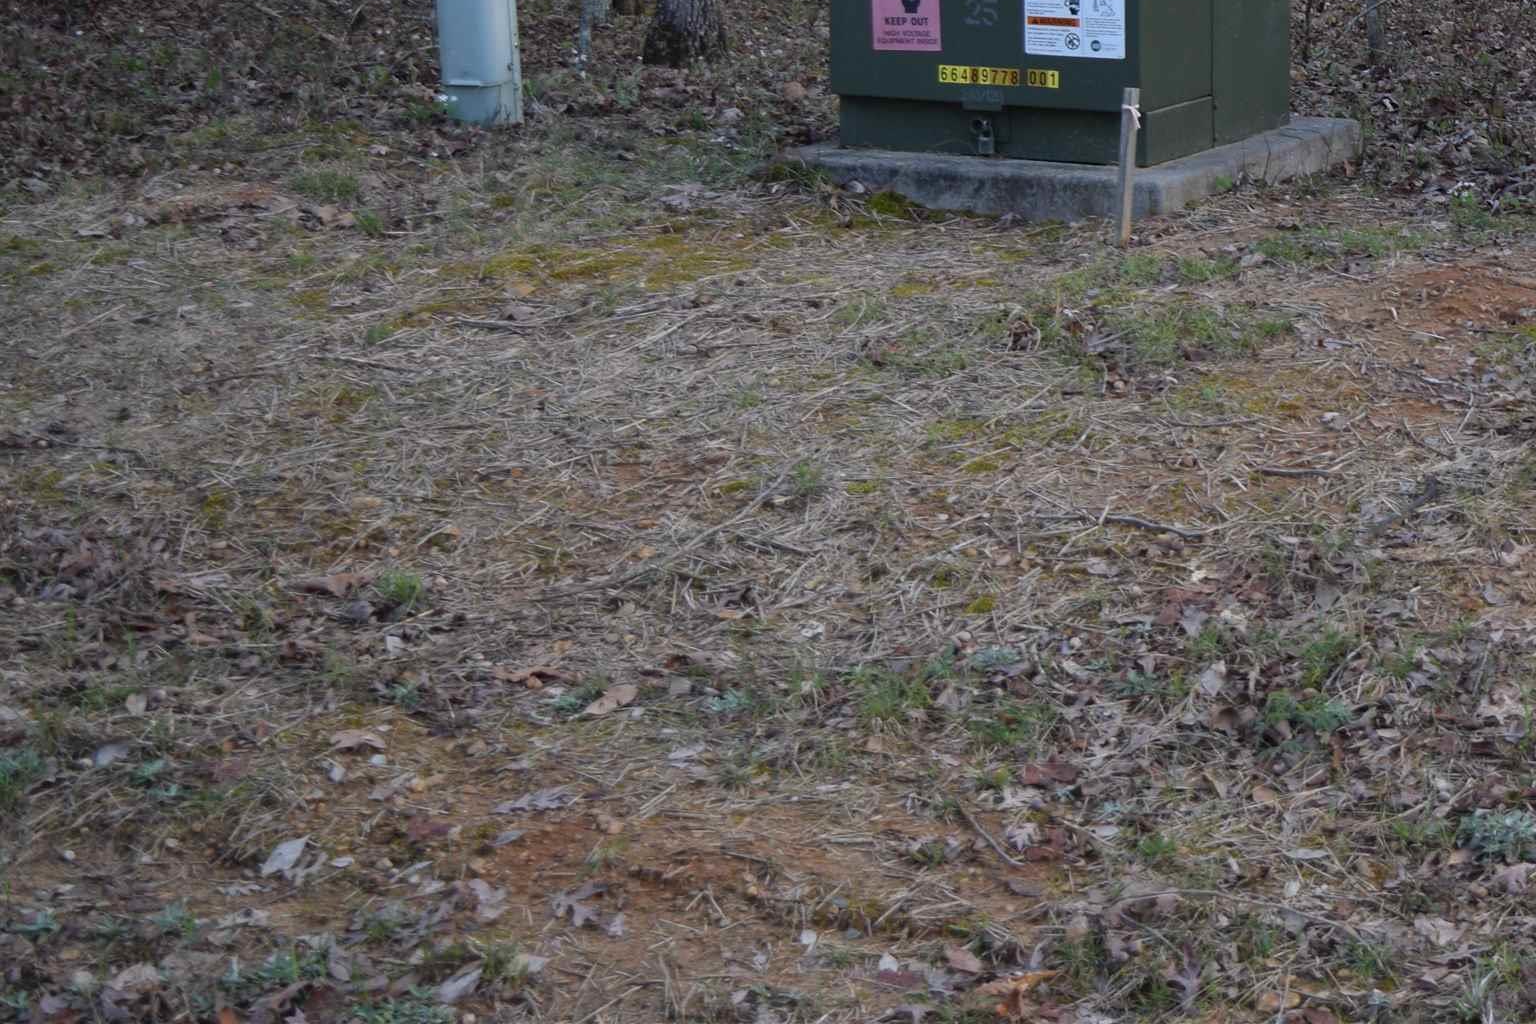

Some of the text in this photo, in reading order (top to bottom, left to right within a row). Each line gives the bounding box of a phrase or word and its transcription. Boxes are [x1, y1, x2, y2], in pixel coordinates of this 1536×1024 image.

[884, 16, 928, 26] KEEP OUT
[939, 66, 1058, 86] 66489778 001
